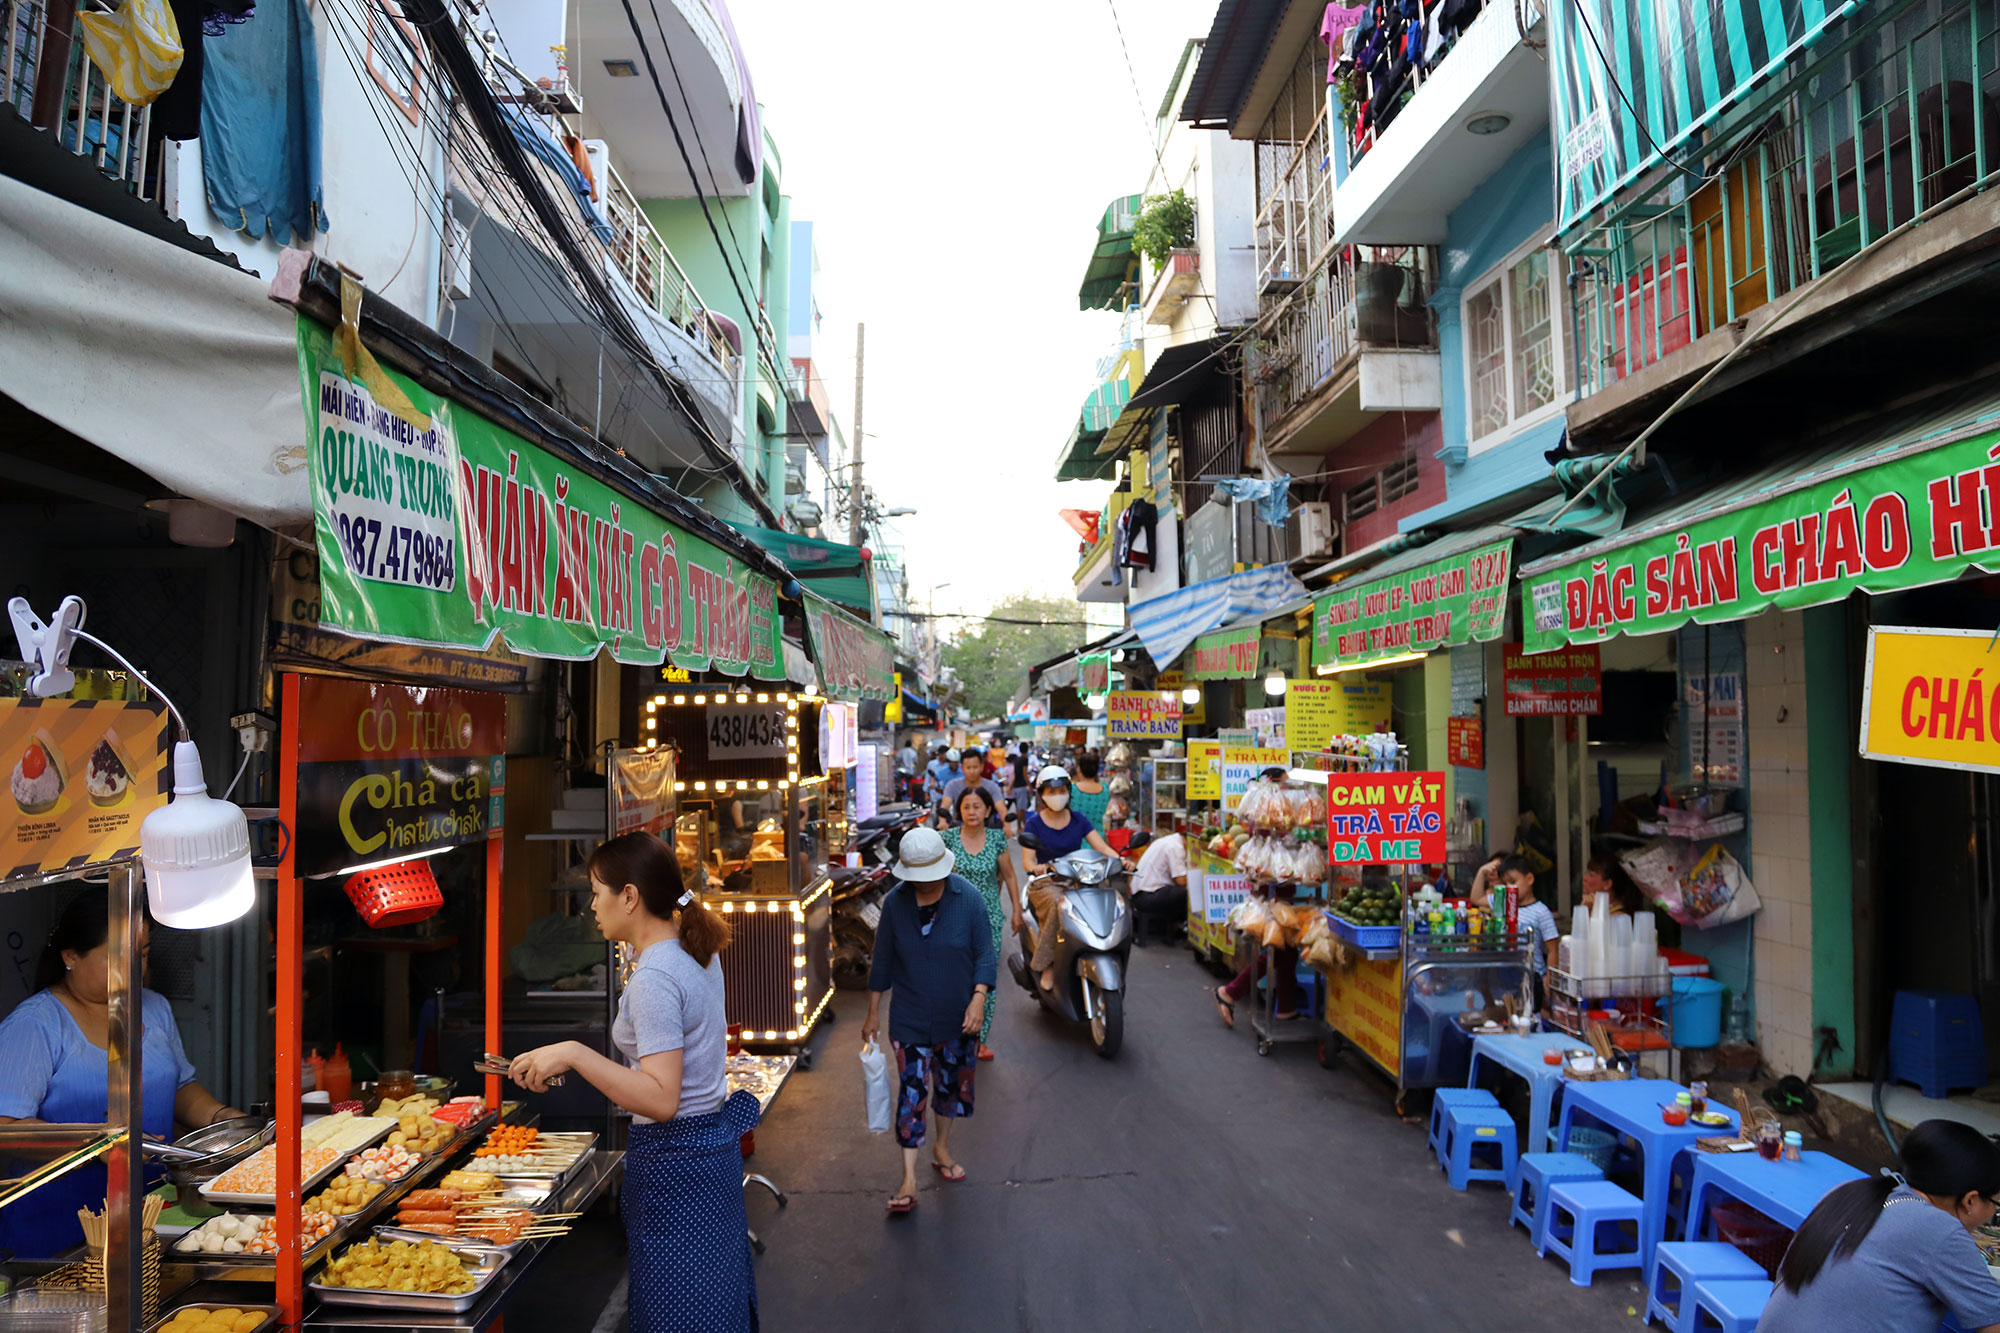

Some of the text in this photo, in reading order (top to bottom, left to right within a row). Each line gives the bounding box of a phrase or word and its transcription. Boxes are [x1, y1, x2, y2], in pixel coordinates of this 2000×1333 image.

[321, 380, 342, 416] MÁI
[345, 389, 366, 426] HIÊN
[322, 425, 453, 522] QUANG TRUNG
[459, 449, 548, 625] QUÁN
[552, 472, 592, 625] ĂN
[640, 530, 682, 651] CÔ
[687, 556, 751, 665] THẢO
[1565, 558, 1636, 636] ĐẶC
[1645, 532, 1740, 618] SẢN
[1751, 488, 1911, 596] CHÁO
[1440, 566, 1465, 599] CAM
[358, 696, 473, 752] CÔ THẢO
[1508, 696, 1533, 714] BÁNH
[1535, 695, 1567, 713] TRÁNG
[1332, 776, 1441, 806] CAM VẮT
[1332, 804, 1441, 835] TRÀ TẮC
[1333, 835, 1422, 862] ĐÁ ME
